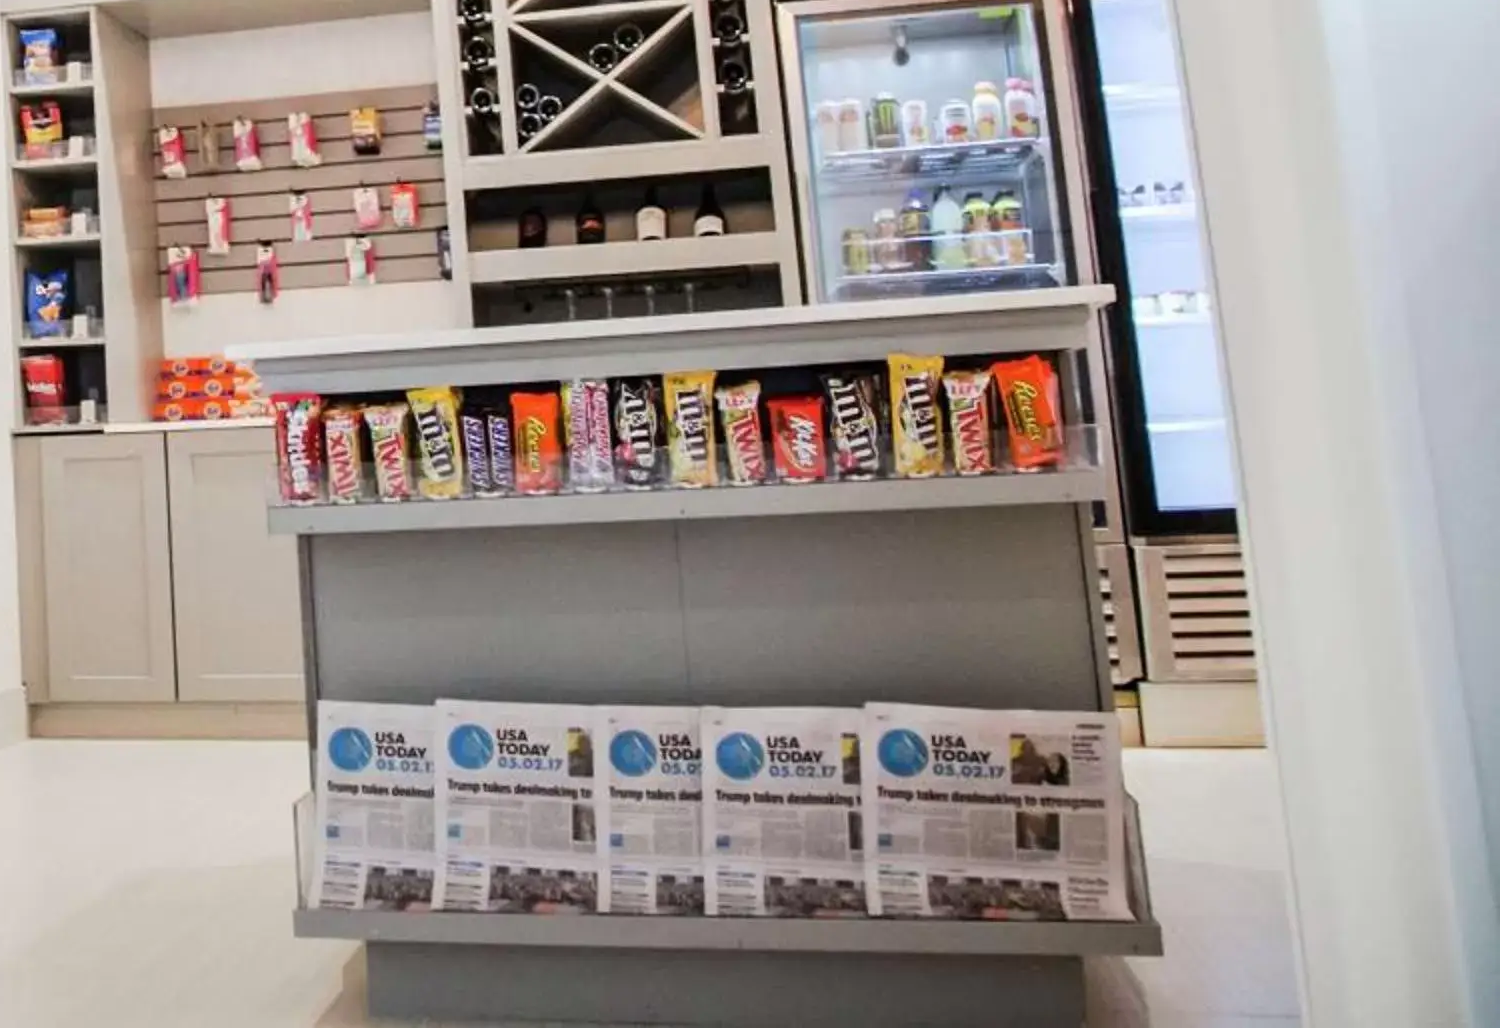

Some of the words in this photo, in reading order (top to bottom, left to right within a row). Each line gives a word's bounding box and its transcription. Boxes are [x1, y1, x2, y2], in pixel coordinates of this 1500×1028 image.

[375, 731, 405, 744] USA
[496, 729, 528, 742] USA
[659, 733, 691, 747] USA
[767, 736, 799, 749] USA
[931, 734, 966, 748] USA
[375, 745, 427, 759] TODAY
[498, 743, 550, 757] TODAY
[768, 750, 823, 763] TODAY
[932, 750, 991, 764] TODAY
[498, 757, 563, 771] 05.02.17
[933, 763, 1004, 779] 05.02.17
[769, 765, 837, 778] 05.02.17
[327, 779, 359, 796] Trump
[361, 783, 389, 795] takes
[447, 778, 481, 795] Trump
[483, 782, 512, 794] takes
[514, 784, 578, 800] dealmaking
[580, 788, 592, 799] to
[610, 785, 644, 802] Trump
[645, 788, 676, 801] takes
[715, 788, 751, 805] Trump
[753, 791, 784, 804] takes
[787, 792, 854, 807] dealmaking
[877, 785, 914, 802] Trump
[916, 789, 950, 802] takes
[951, 791, 1022, 808] dealmaking
[1024, 795, 1038, 806] to
